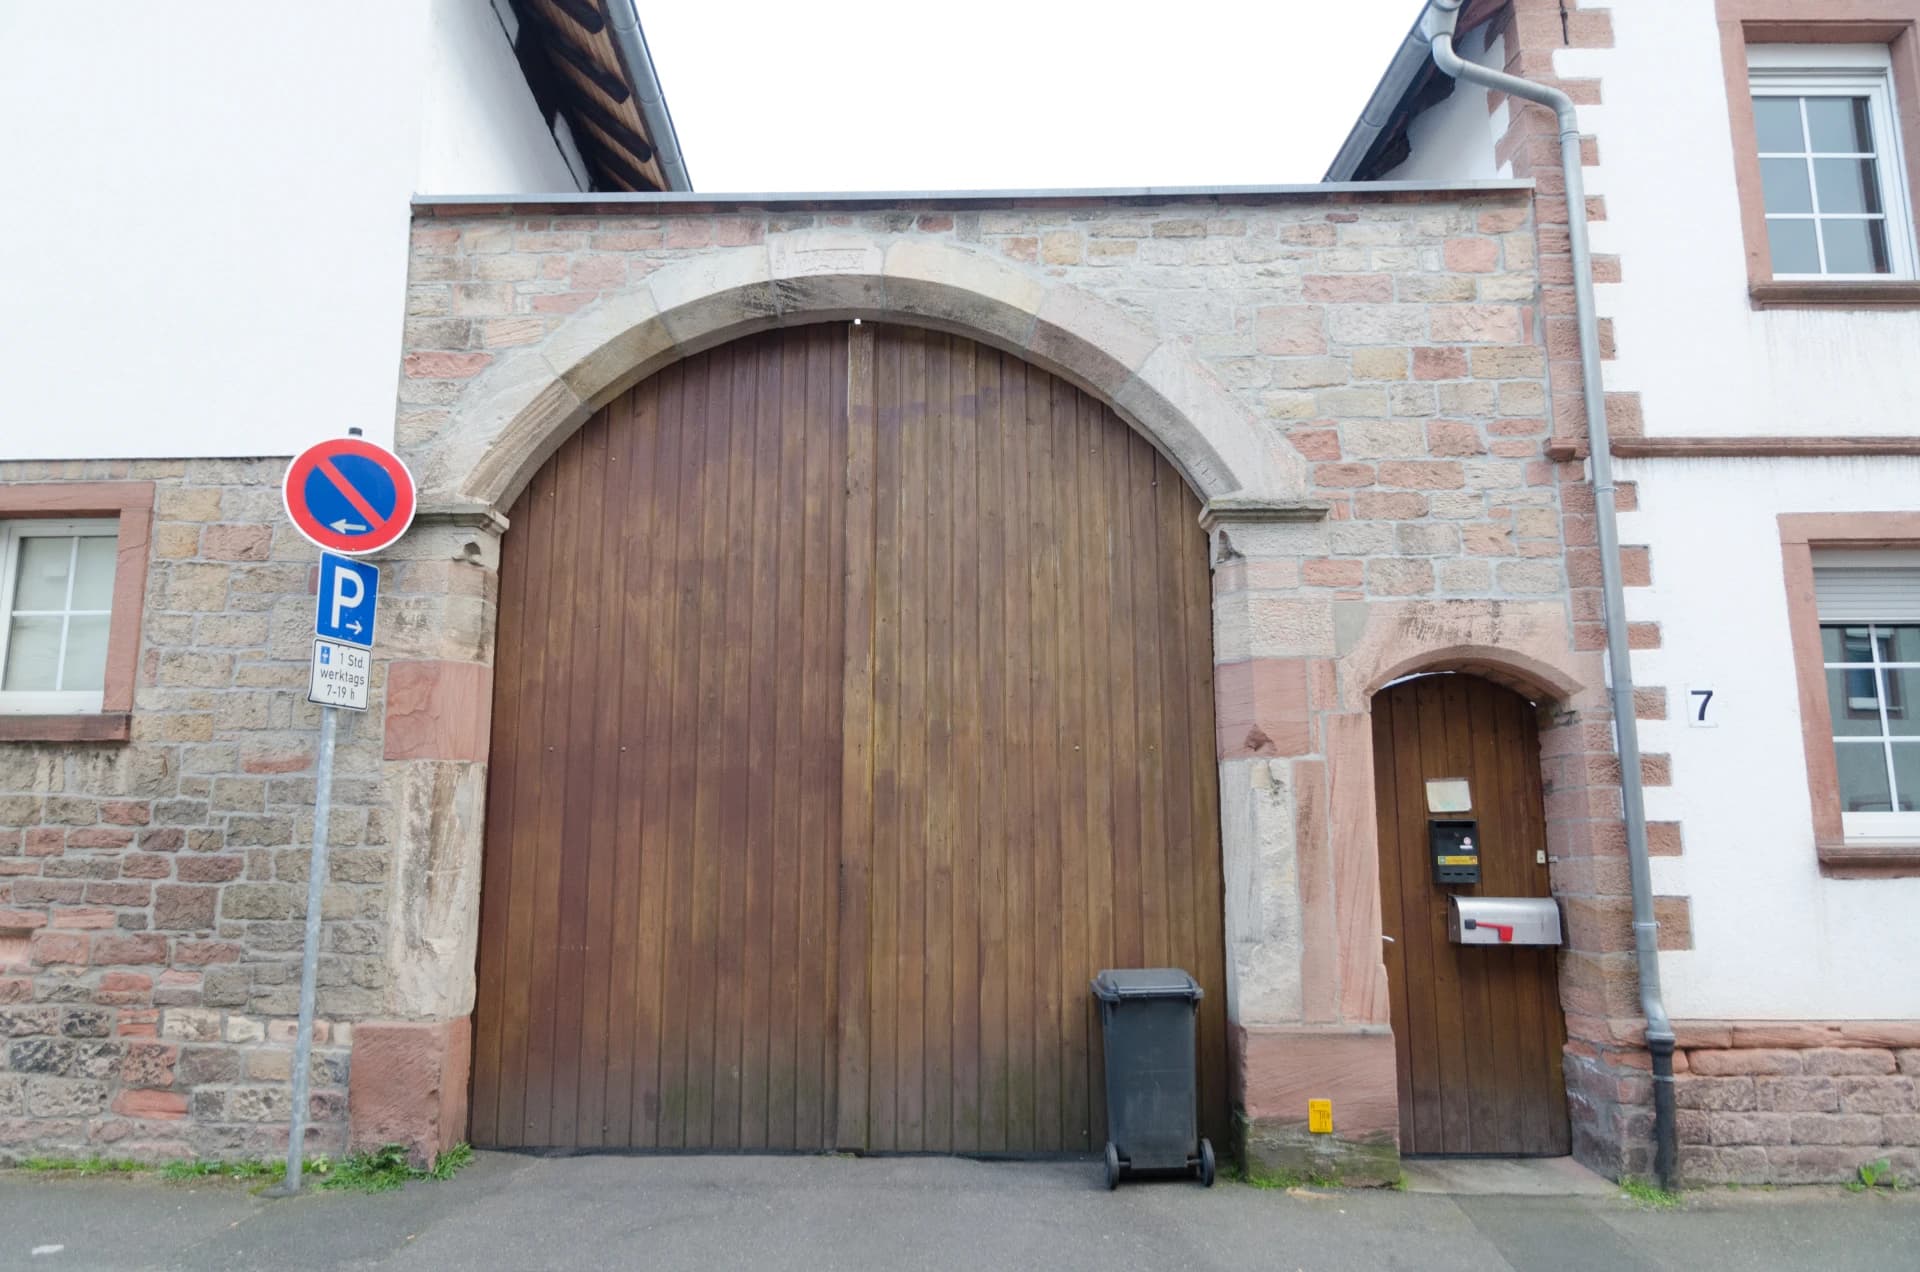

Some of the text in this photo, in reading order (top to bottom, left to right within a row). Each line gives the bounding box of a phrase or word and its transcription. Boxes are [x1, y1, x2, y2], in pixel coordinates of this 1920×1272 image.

[331, 565, 364, 629] P
[340, 653, 365, 670] 1 Std.
[320, 668, 365, 688] werktags
[327, 684, 355, 701] 7-19 h
[1691, 690, 1713, 721] 7
